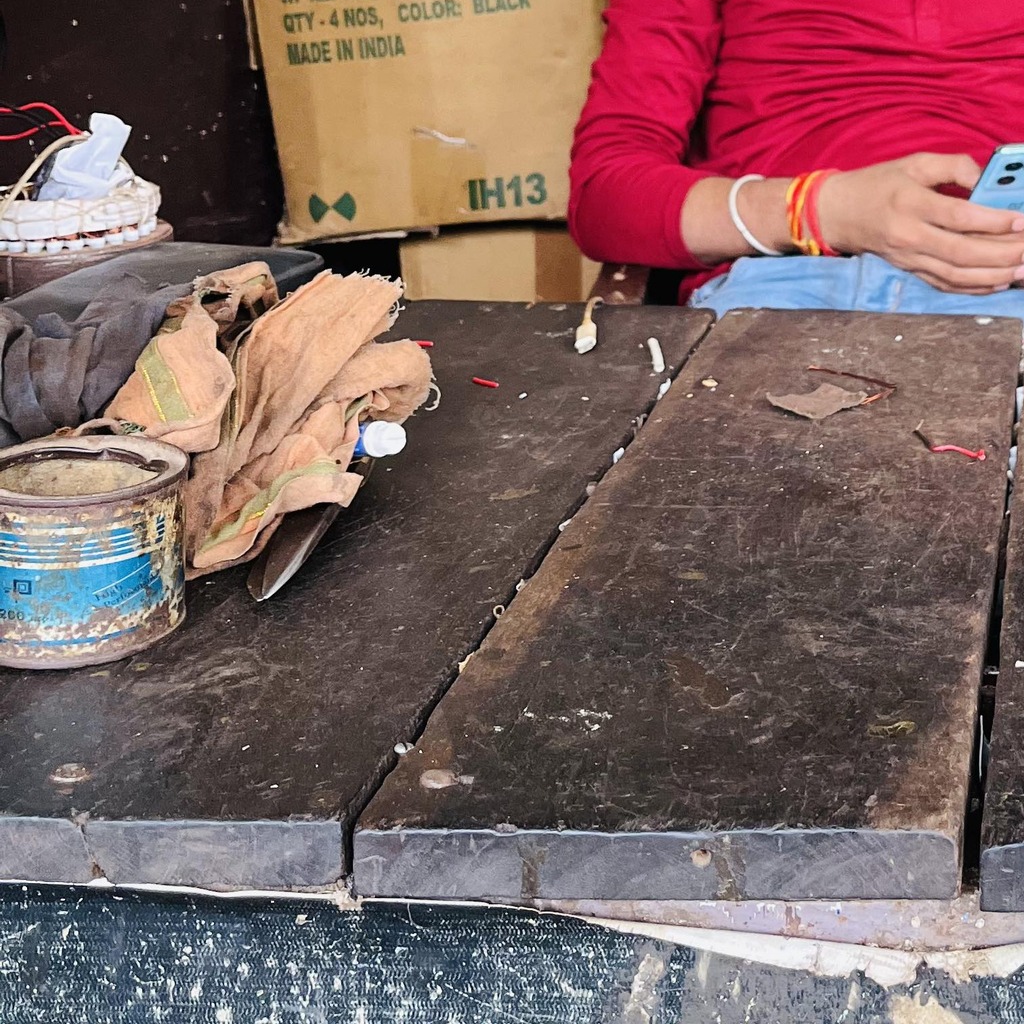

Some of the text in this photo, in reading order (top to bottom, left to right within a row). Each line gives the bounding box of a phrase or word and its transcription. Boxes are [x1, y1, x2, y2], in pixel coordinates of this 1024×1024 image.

[283, 11, 314, 34] QTY
[329, 8, 339, 29] 4
[343, 7, 384, 30] NOS,
[287, 35, 406, 65] MADE IN INDIA
[468, 172, 547, 211] IH13
